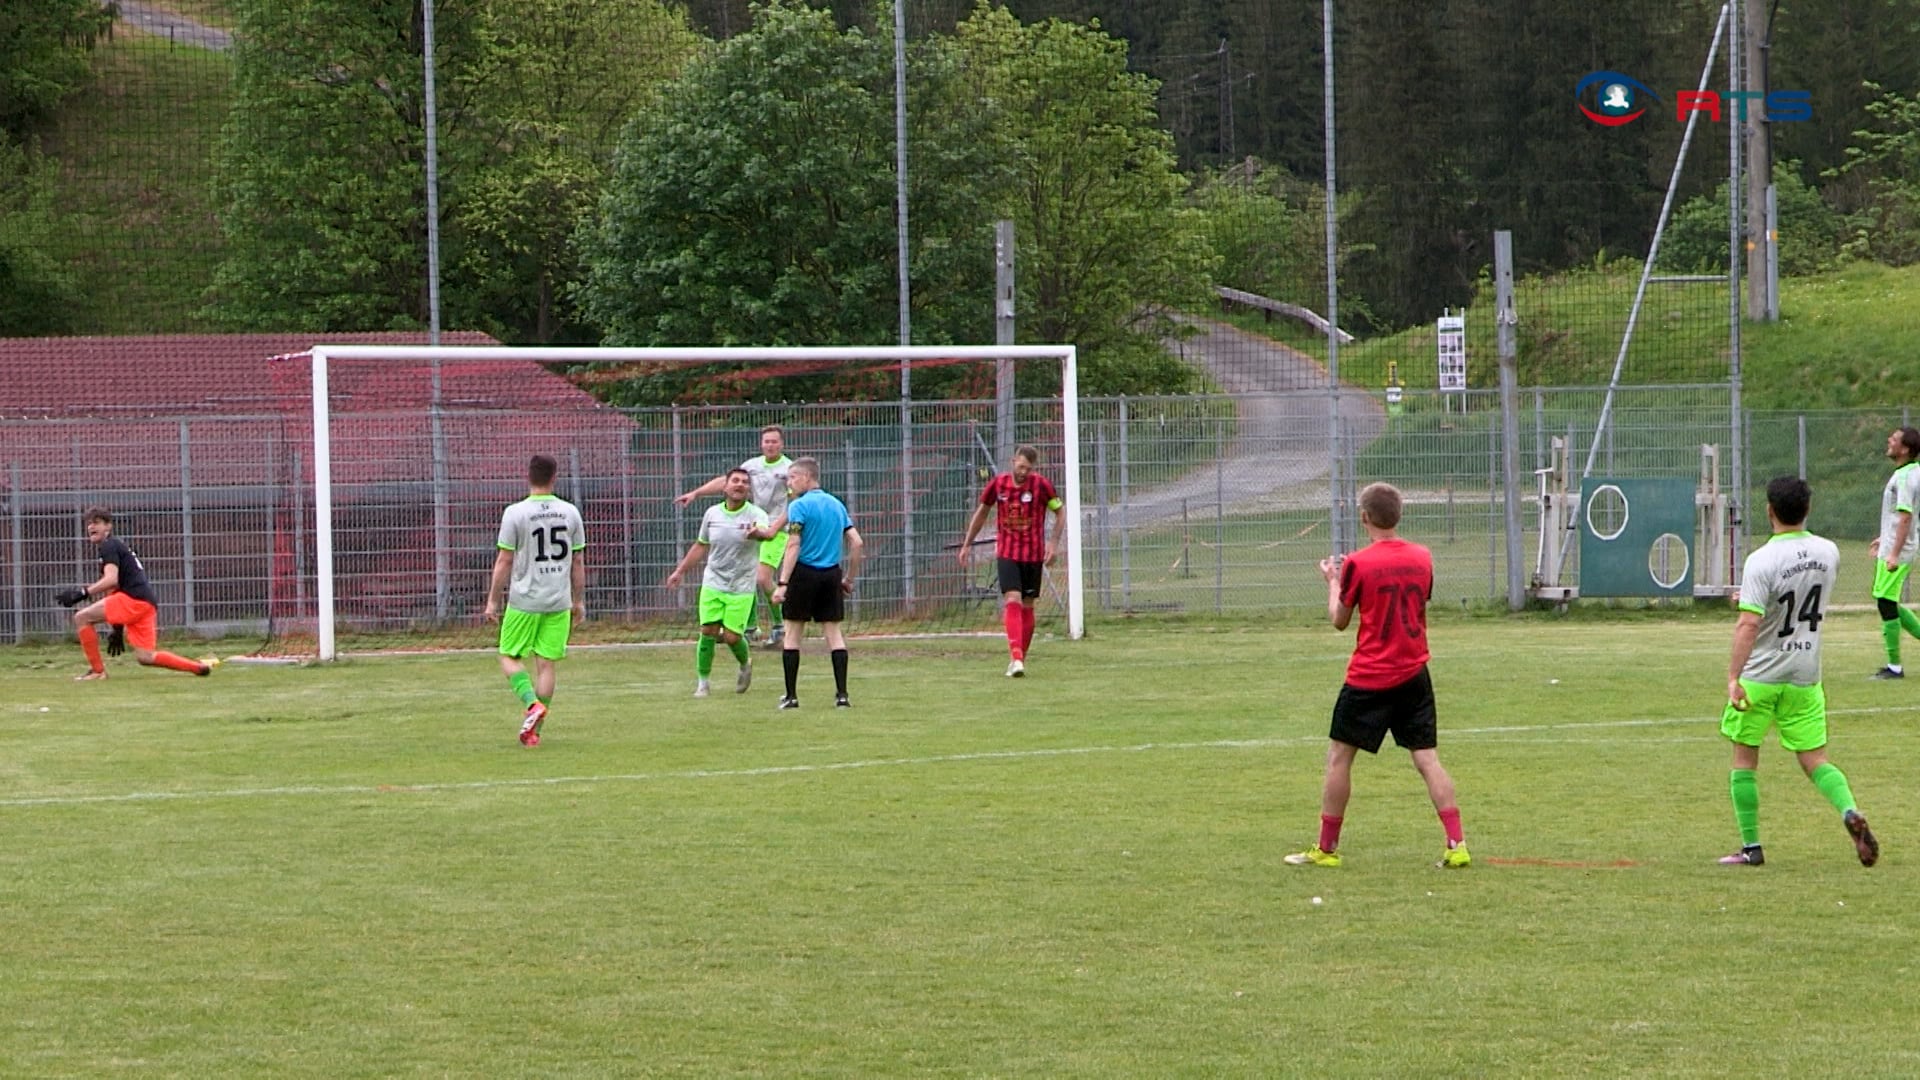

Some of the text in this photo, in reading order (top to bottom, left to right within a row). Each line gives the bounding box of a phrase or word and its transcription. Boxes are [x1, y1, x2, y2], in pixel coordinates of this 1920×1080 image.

[532, 526, 568, 561] 15
[1377, 583, 1425, 643] 70
[1777, 584, 1823, 638] 14
